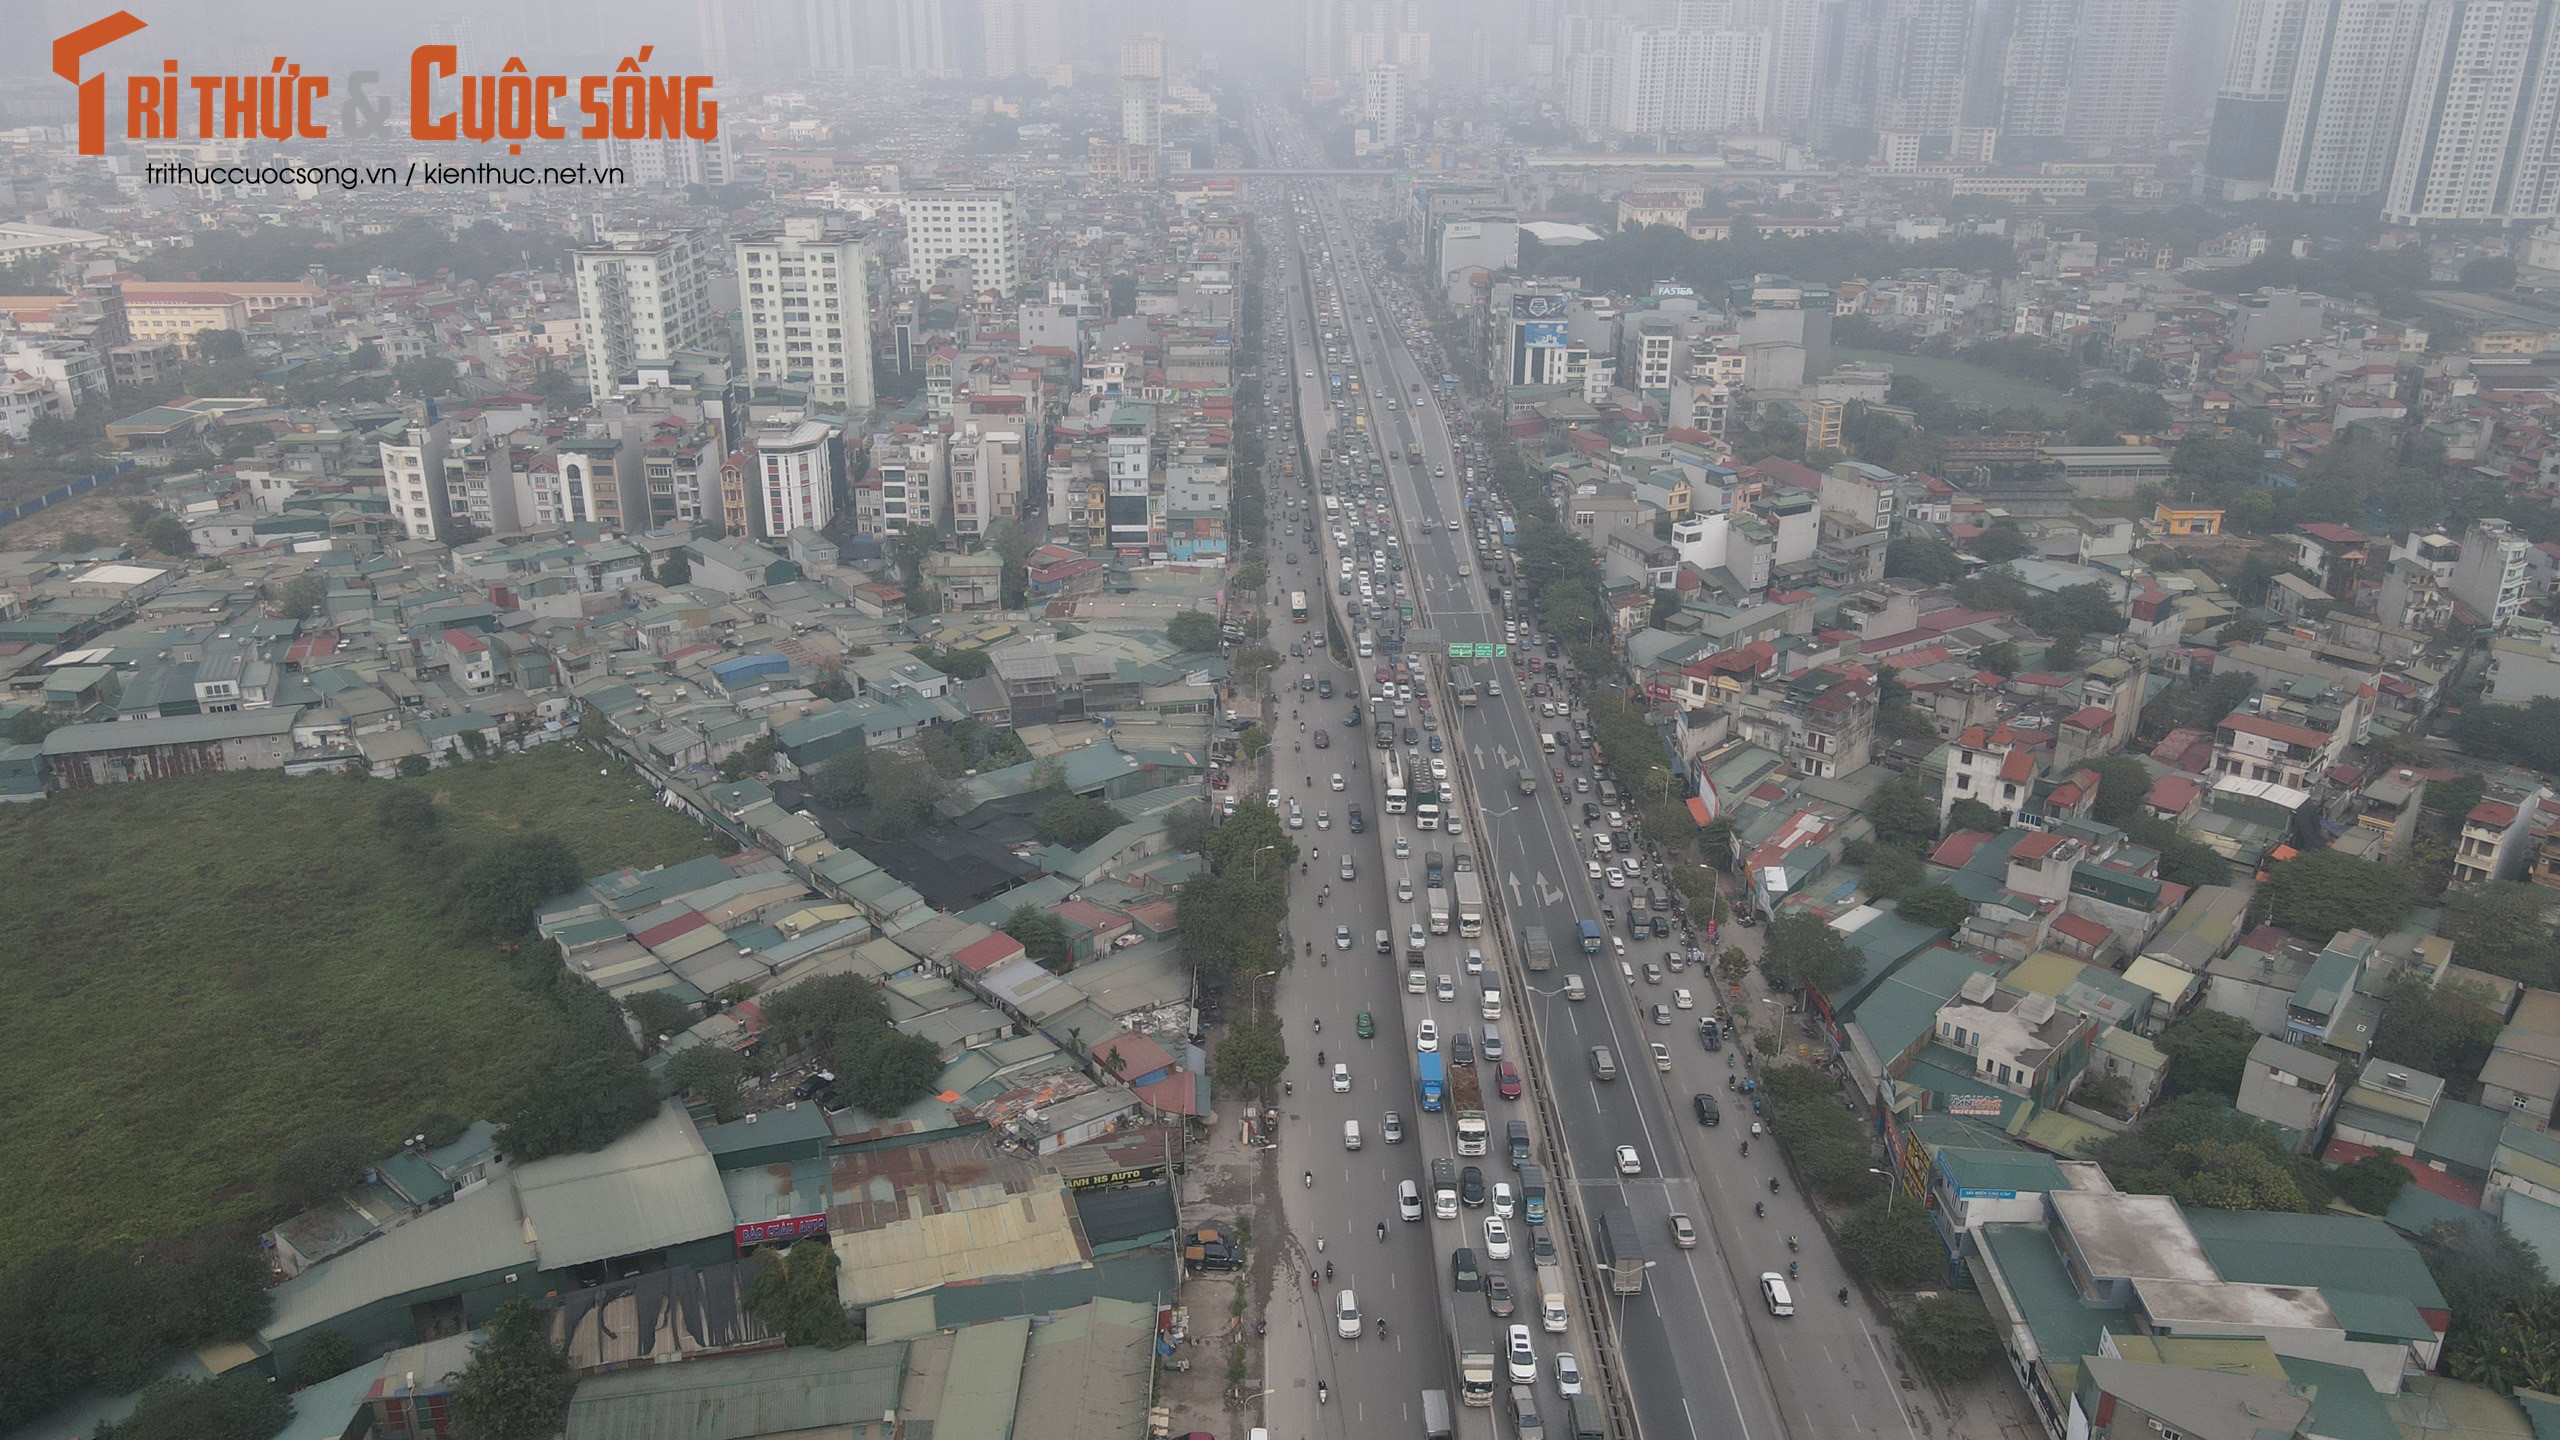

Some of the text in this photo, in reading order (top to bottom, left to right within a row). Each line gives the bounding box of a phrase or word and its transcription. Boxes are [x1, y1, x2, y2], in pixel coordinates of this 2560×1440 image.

[1093, 1174, 1109, 1185] HS
[1111, 1170, 1141, 1182] AUTO
[799, 1217, 826, 1233] AUTO
